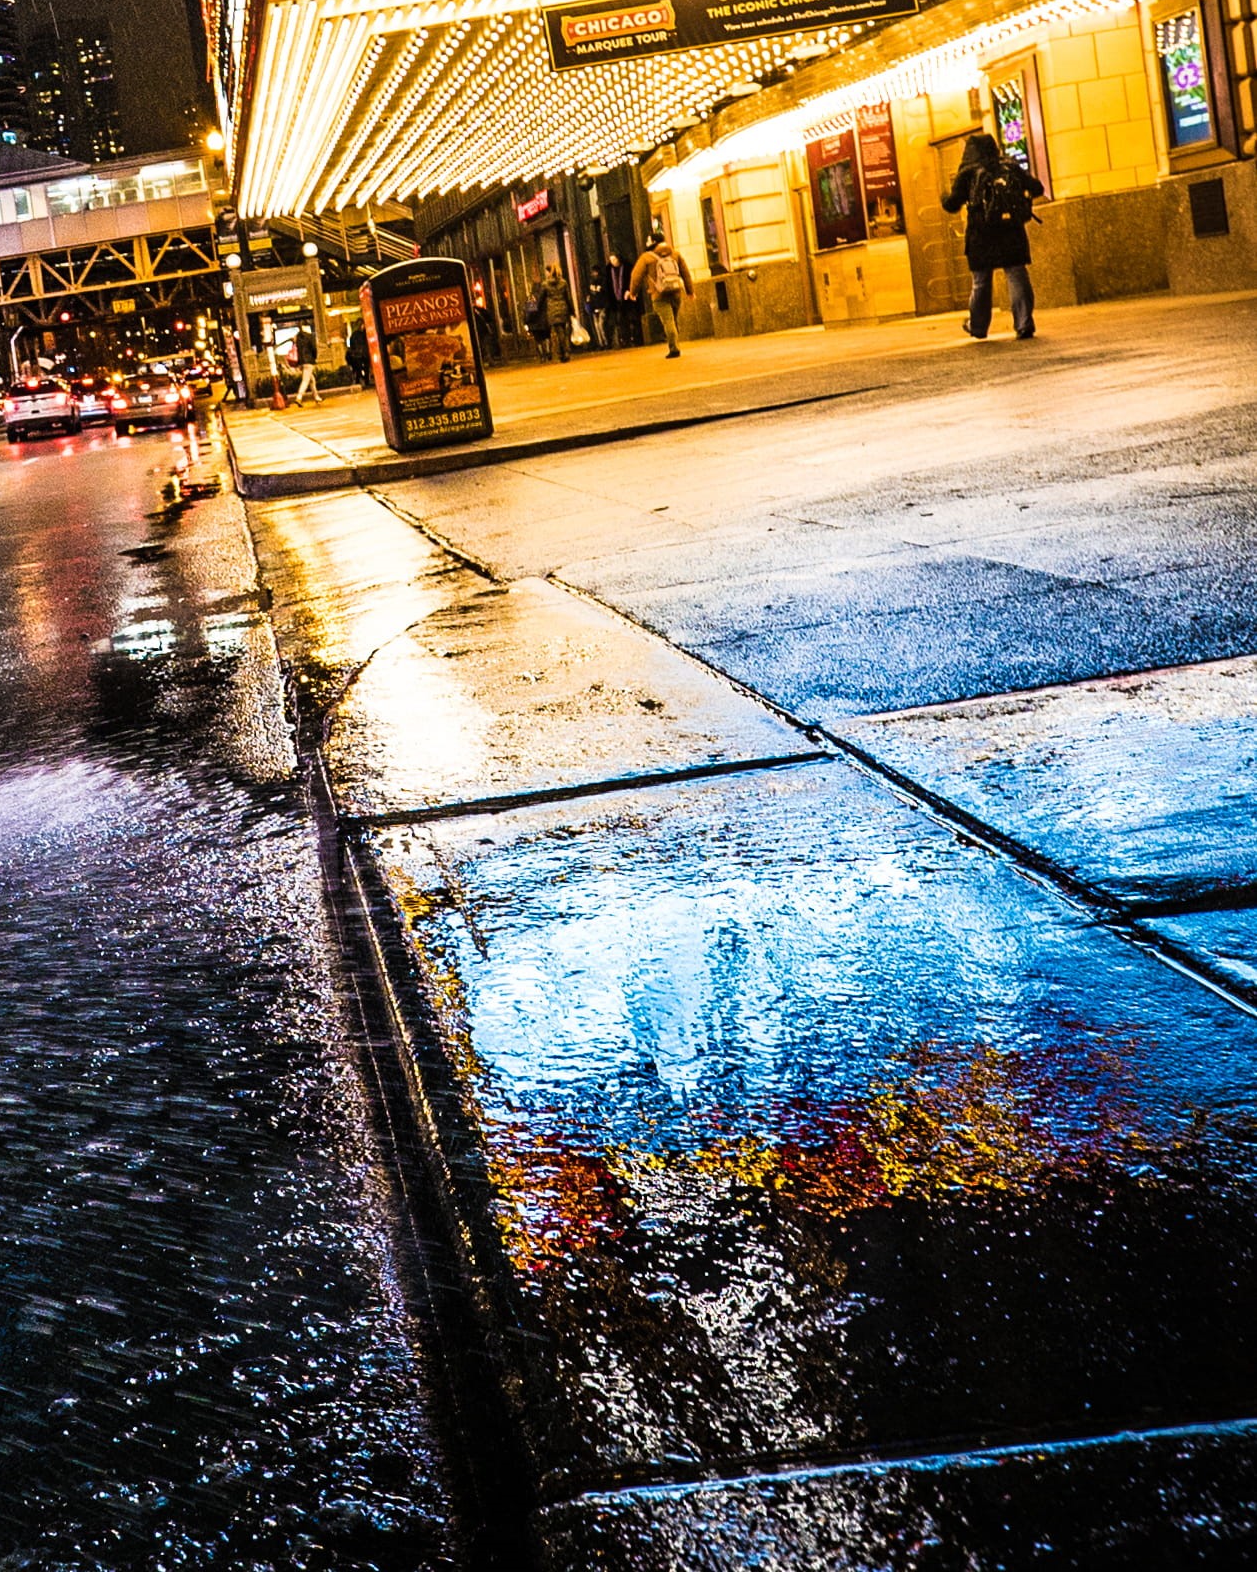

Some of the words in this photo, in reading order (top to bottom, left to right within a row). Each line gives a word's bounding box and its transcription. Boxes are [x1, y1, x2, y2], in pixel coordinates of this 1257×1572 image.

[574, 10, 662, 36] CHICAGO
[706, 5, 732, 19] THE
[576, 36, 634, 55] MARQUEE
[635, 31, 668, 45] TOUR
[386, 293, 460, 318] PIZANO'S
[388, 315, 418, 329] PIZZA
[419, 314, 429, 323] &
[429, 308, 463, 321] PASTA
